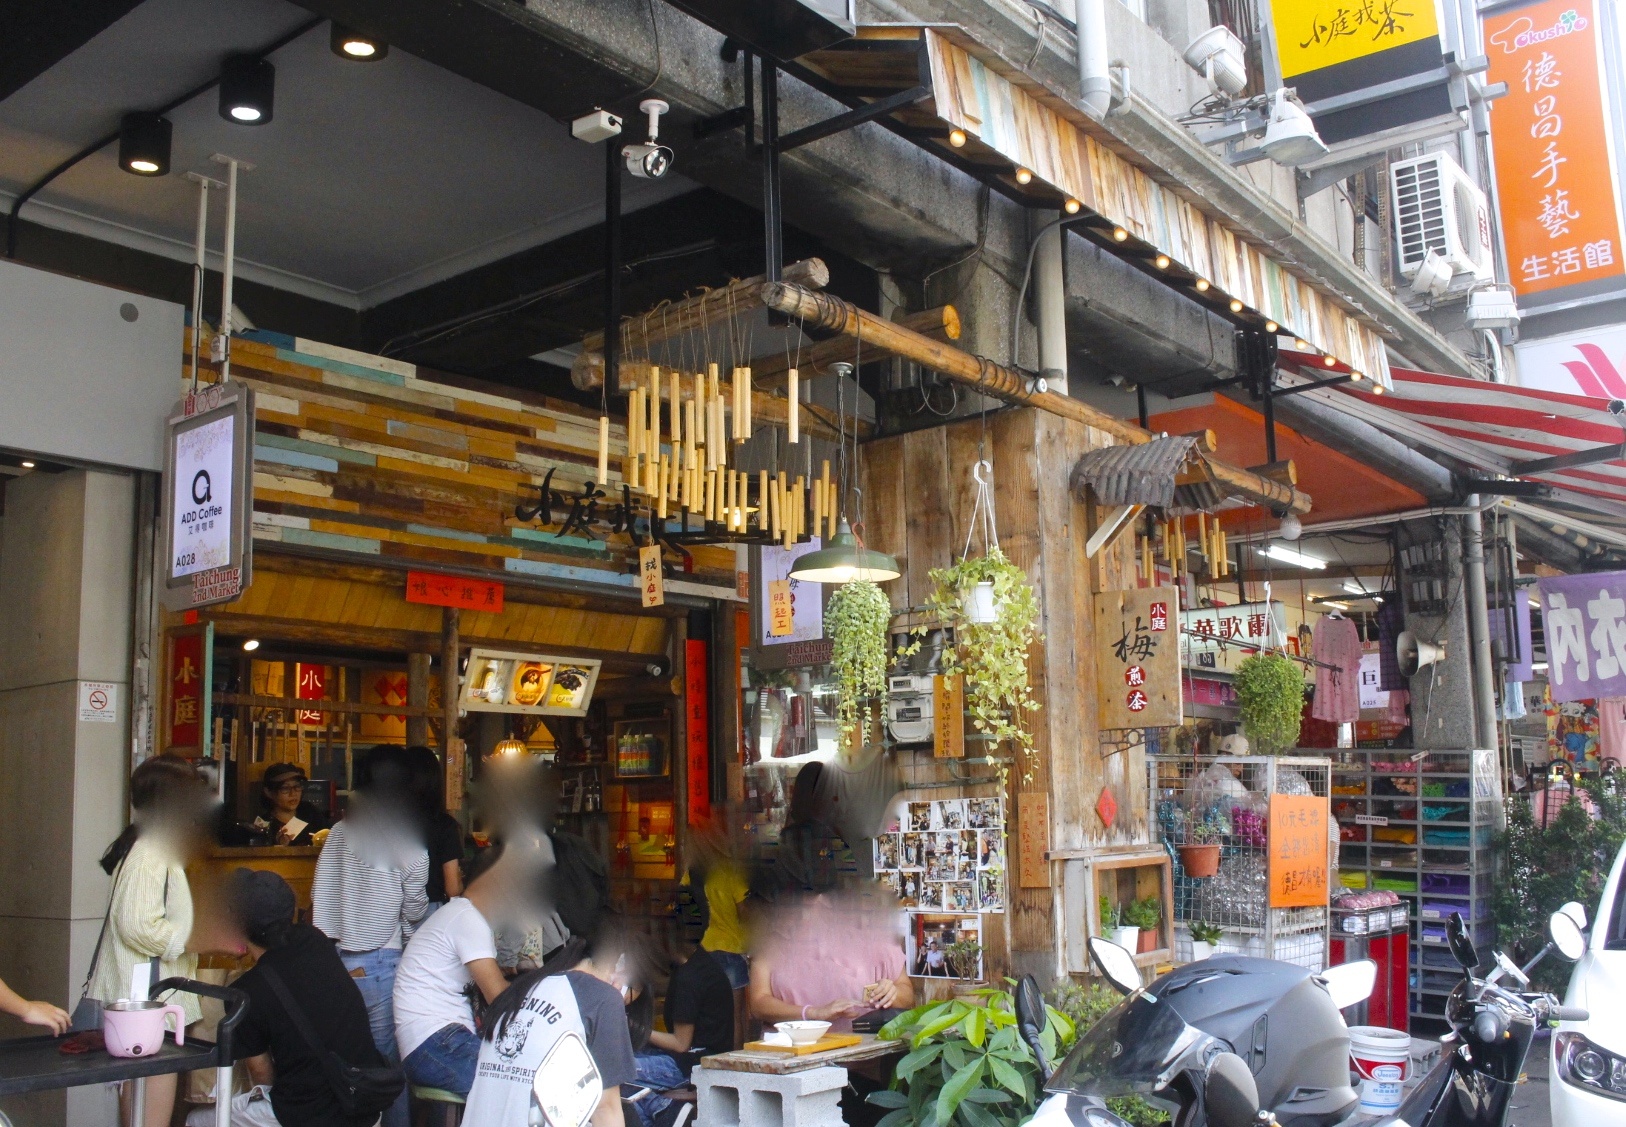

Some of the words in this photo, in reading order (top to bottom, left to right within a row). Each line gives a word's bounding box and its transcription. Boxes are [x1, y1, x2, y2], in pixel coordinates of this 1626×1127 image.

[1300, 0, 1414, 49] 小庭找茶
[1521, 51, 1581, 239] 德昌手藝
[1520, 239, 1614, 283] 生活館
[181, 511, 197, 524] ADD
[198, 505, 223, 520] Coffee
[175, 552, 196, 568] A028
[192, 567, 240, 589] Taichung
[192, 588, 208, 603] 2nd
[209, 583, 240, 599] Market
[1151, 603, 1167, 631] 小庭
[1193, 613, 1270, 642] 華歌爾
[1547, 588, 1626, 686] 內衣
[786, 641, 834, 657] Taichung
[787, 654, 803, 666] 2nd
[804, 650, 832, 665] Marke
[1362, 670, 1378, 686] 巨
[175, 656, 198, 726] 小庭
[479, 1062, 505, 1073] ORIGINAL
[511, 1066, 537, 1079] SPIRIT
